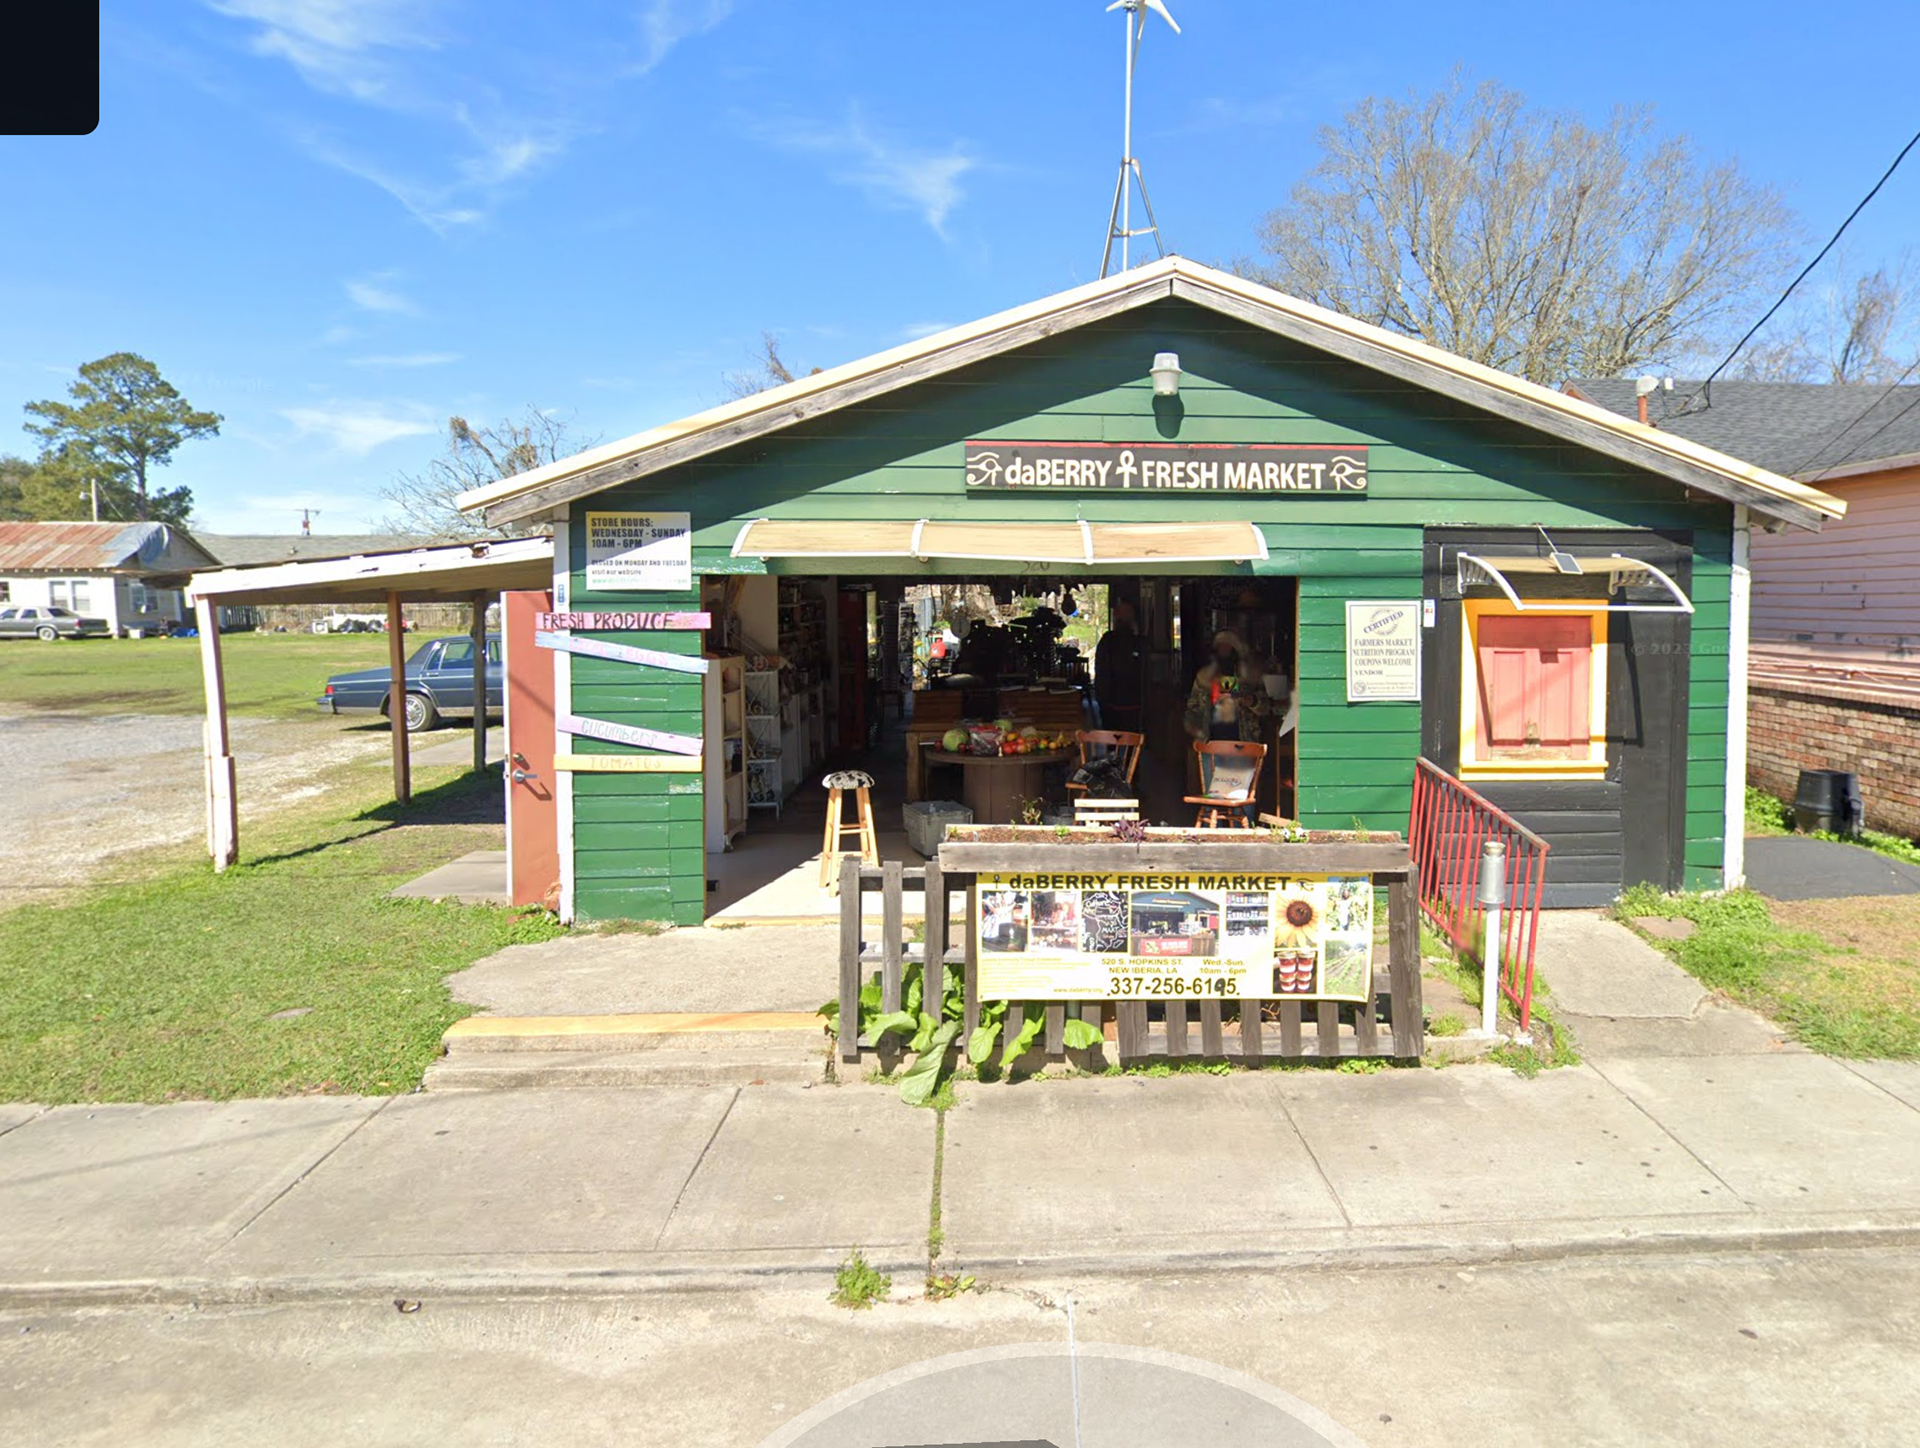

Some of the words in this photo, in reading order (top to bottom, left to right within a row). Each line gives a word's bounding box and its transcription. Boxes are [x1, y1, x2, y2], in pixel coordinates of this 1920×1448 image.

[1004, 457, 1111, 488] daBERRY
[1142, 460, 1217, 489] FRESH
[1224, 462, 1326, 490] MARKET
[591, 518, 619, 527] STORE
[621, 518, 653, 527] HOURS:
[591, 529, 643, 538] WEDNESDAY
[651, 529, 686, 538] SUNDAY
[592, 539, 615, 548] 10AM
[623, 539, 642, 548] 6PM
[543, 612, 584, 630] FRESH
[1363, 610, 1404, 634] CERTIFIED
[1354, 639, 1384, 647] FARMERS
[1385, 639, 1412, 647] MARKET
[1353, 649, 1384, 657] NUTRITION
[1385, 649, 1415, 657] PROGRAM
[1354, 658, 1381, 666] COUPONS
[1383, 658, 1412, 666] WELCOME
[1009, 875, 1109, 890] daBERRY
[1118, 876, 1190, 890] FRESH
[1198, 876, 1291, 891] MARKET
